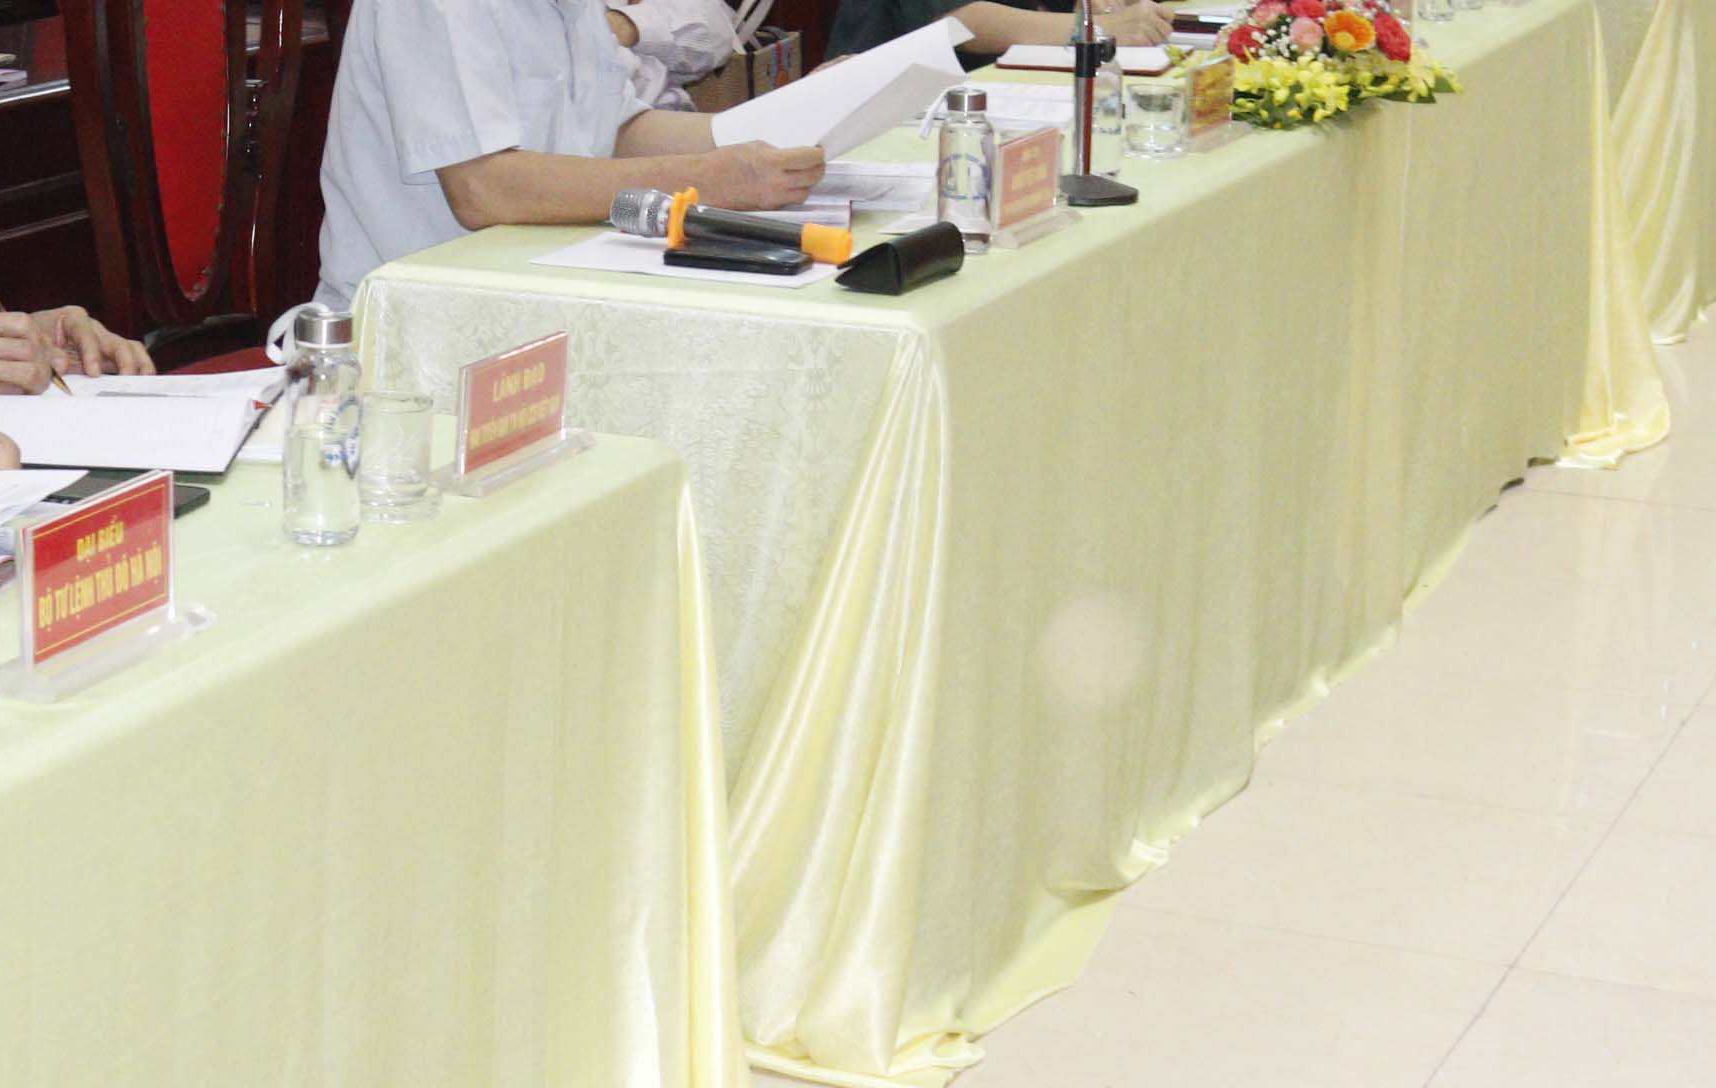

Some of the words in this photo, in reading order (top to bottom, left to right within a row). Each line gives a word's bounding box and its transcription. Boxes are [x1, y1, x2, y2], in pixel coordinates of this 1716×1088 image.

[76, 533, 96, 562] ĐẠI
[98, 515, 123, 552] BIỂU
[39, 587, 53, 632] BỘ
[69, 575, 95, 620] LỆNH
[95, 553, 113, 603] THỦ
[130, 547, 144, 587] HÀ
[145, 541, 162, 584] NỘI
